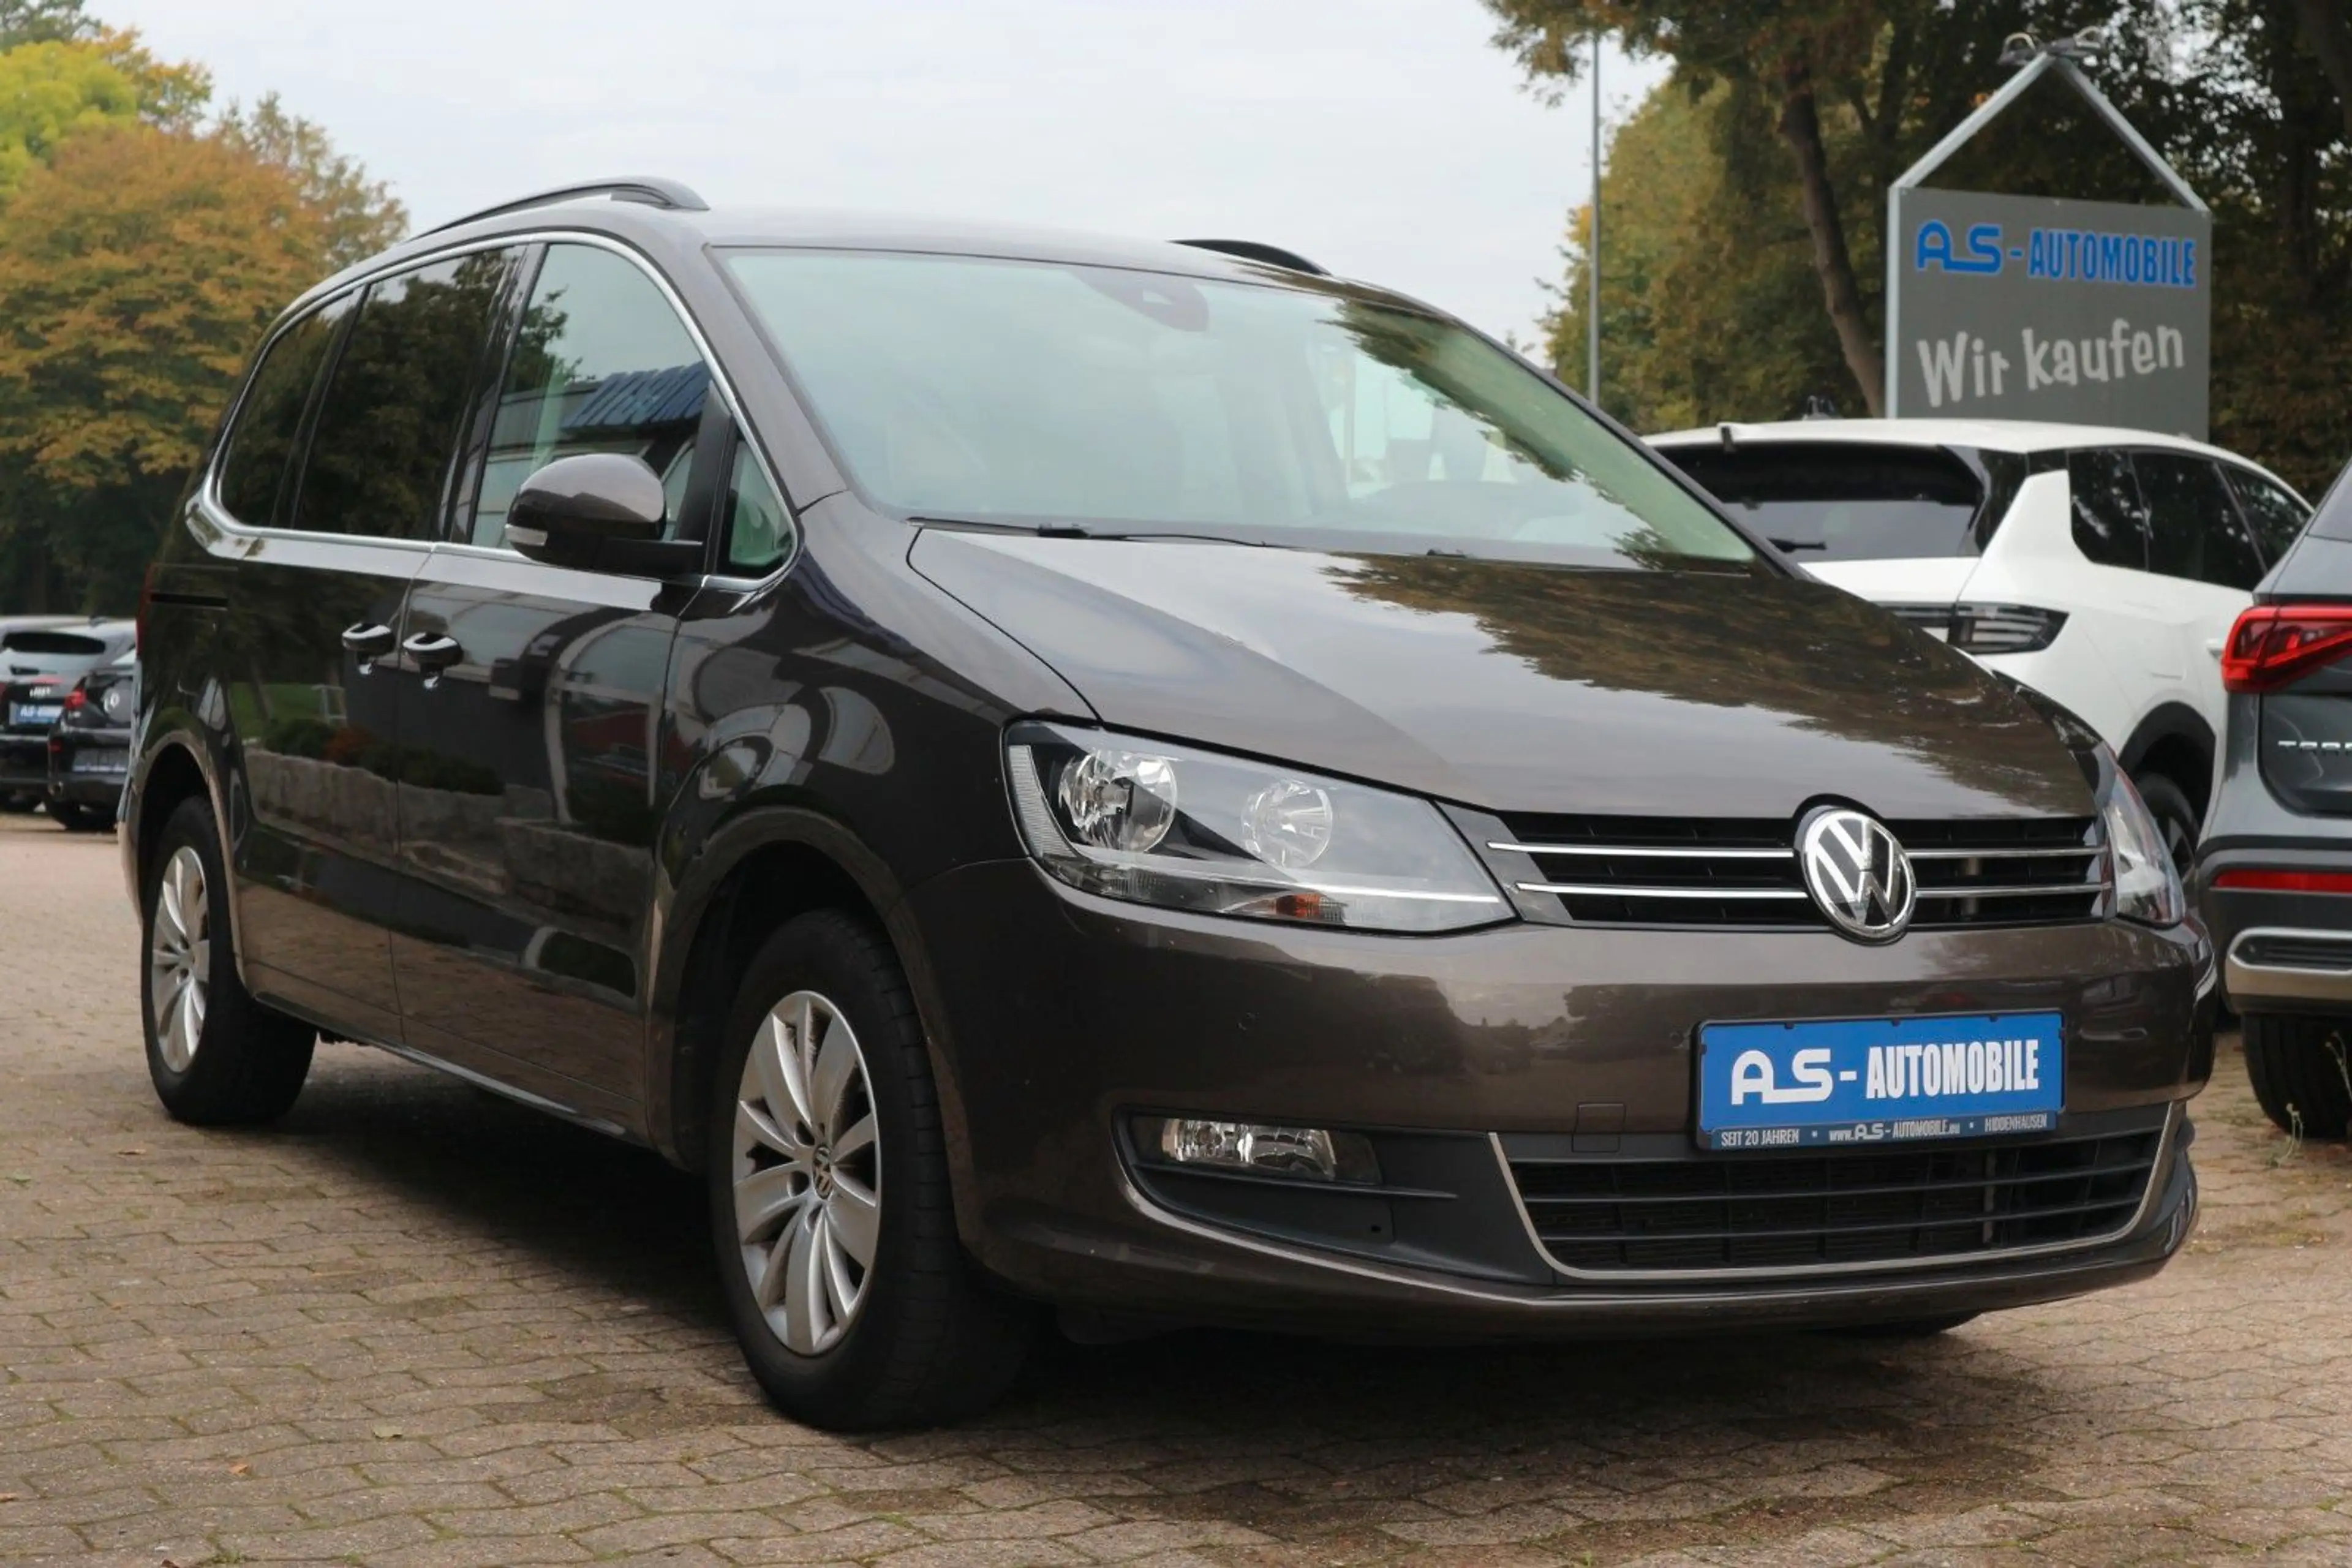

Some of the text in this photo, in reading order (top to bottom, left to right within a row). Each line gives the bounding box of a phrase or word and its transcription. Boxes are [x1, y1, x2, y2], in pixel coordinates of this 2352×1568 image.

[1916, 318, 2185, 408] Wir kaufen
[1721, 1131, 1742, 1147] SEIT
[1745, 1131, 1759, 1146] 20
[1760, 1128, 1800, 1145] JAHREN
